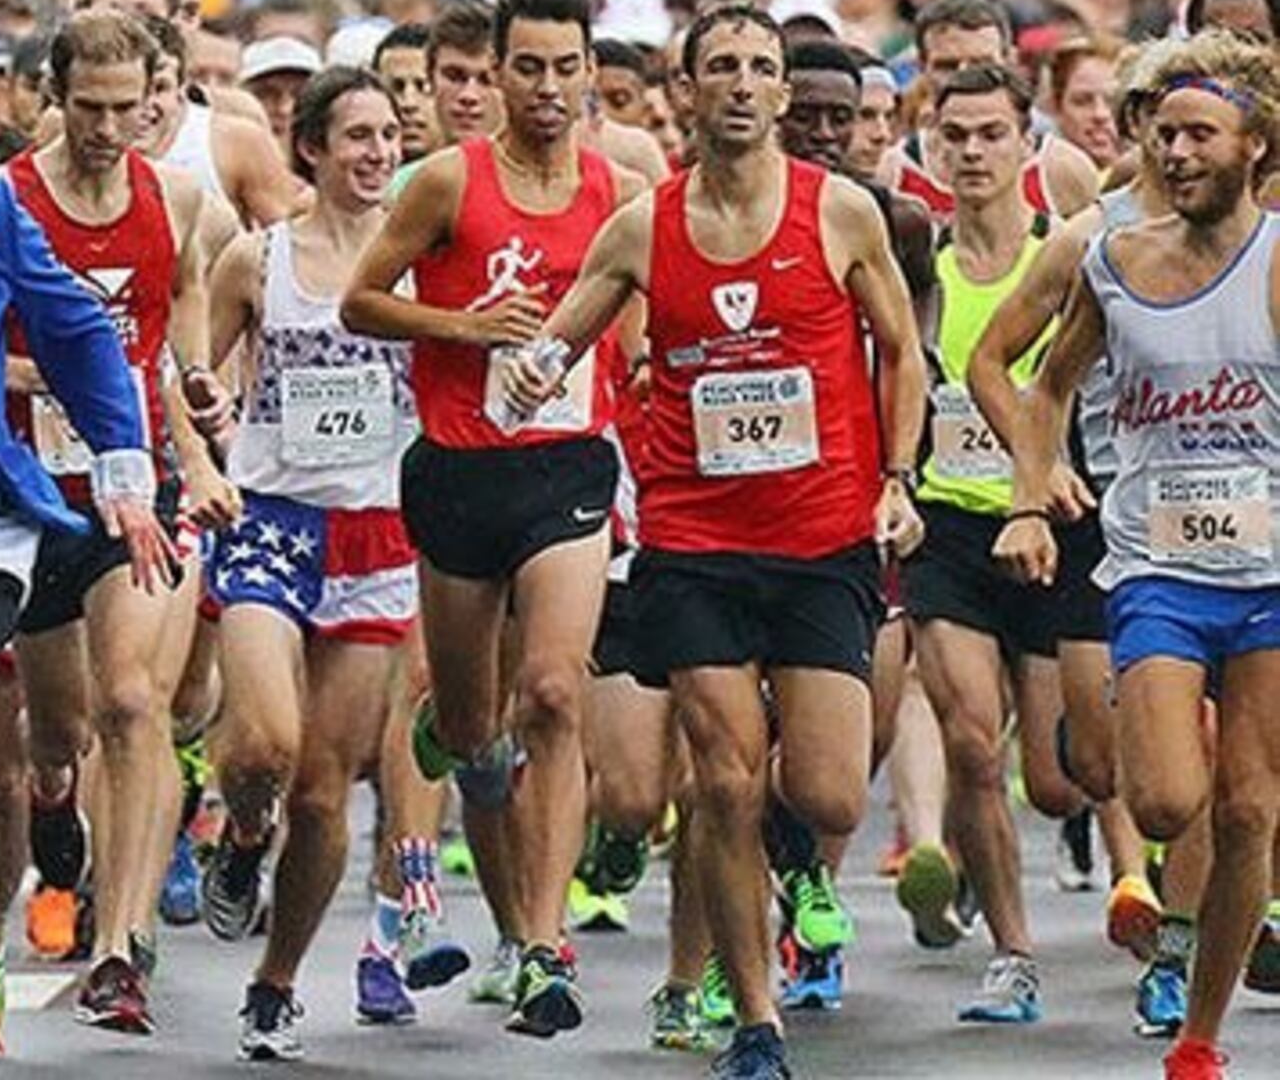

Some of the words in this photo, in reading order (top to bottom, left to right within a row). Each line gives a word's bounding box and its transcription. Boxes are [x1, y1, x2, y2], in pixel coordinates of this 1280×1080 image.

[1111, 366, 1266, 437] Alanta
[315, 409, 367, 435] 476
[726, 415, 782, 442] 367
[1181, 513, 1238, 542] 504
